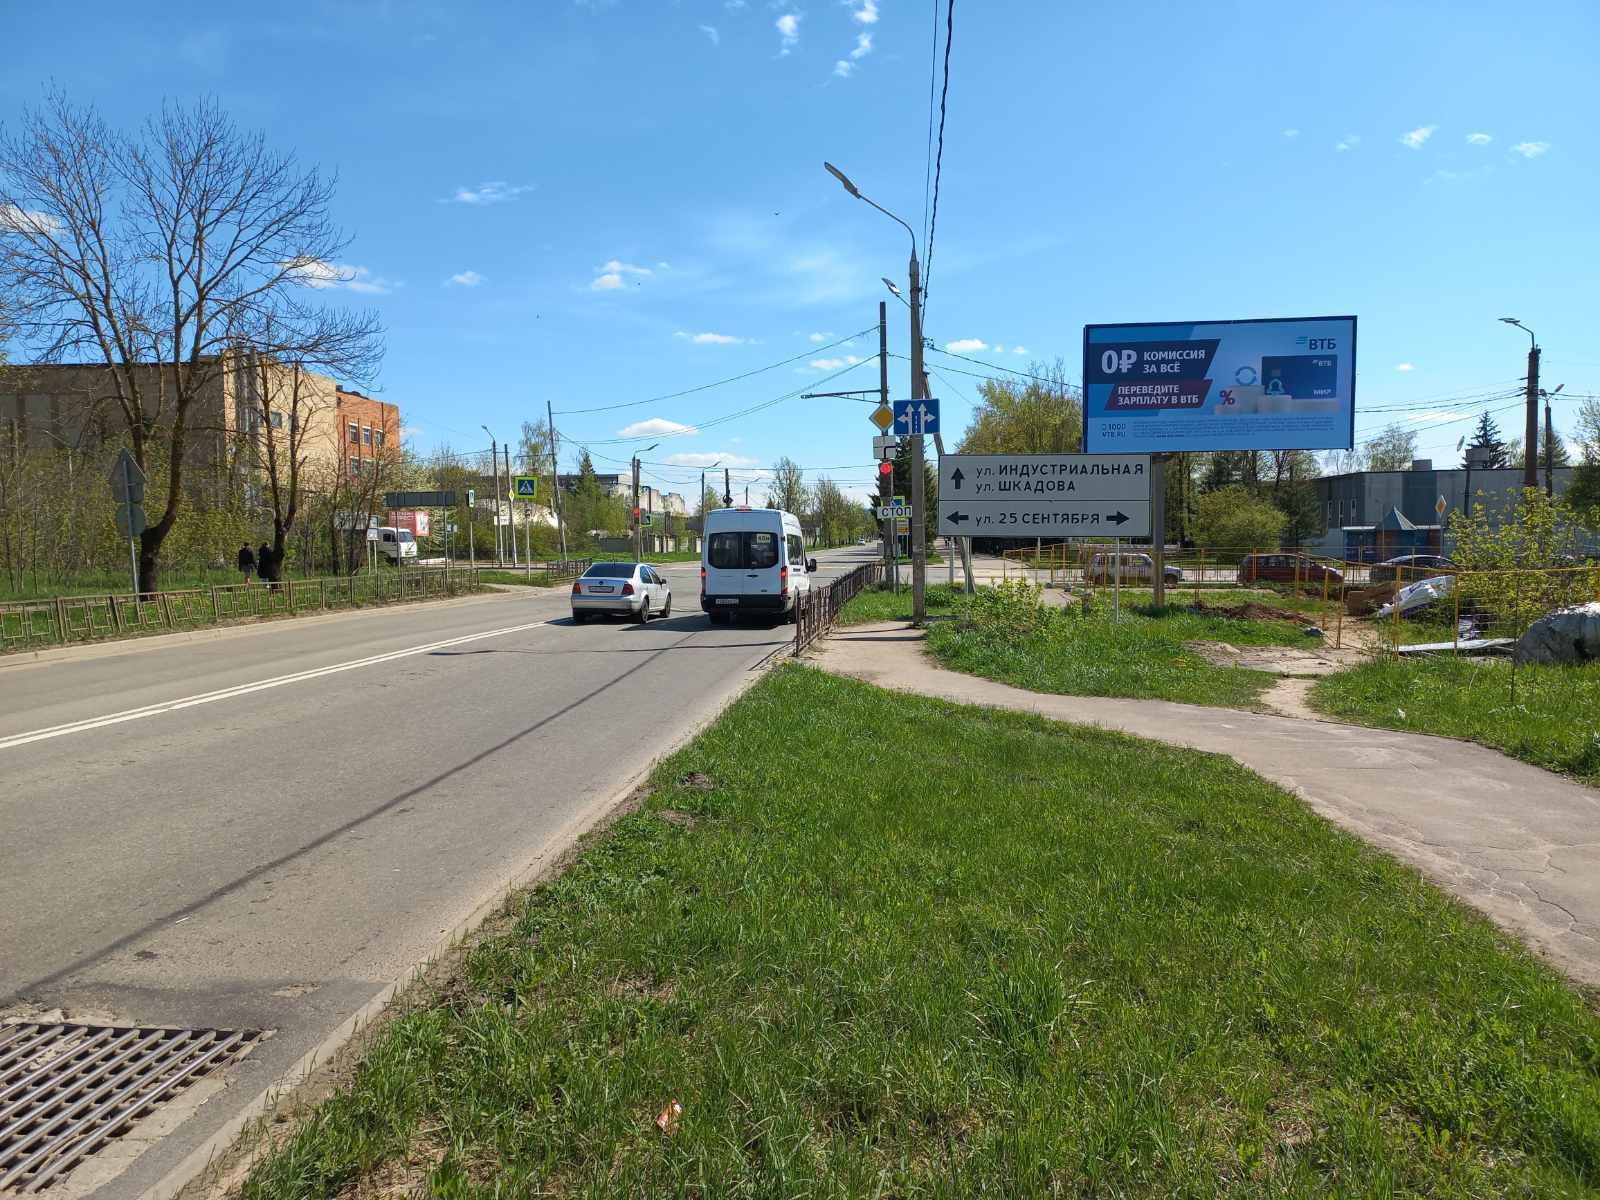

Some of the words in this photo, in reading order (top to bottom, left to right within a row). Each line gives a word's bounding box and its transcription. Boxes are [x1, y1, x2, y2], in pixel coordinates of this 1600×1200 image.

[1309, 338, 1337, 351] ВТБ
[1143, 349, 1206, 361] КОМИССИЯ
[1143, 364, 1158, 374] ЗА
[1160, 361, 1182, 373] ВСЁ
[1118, 384, 1180, 395] ПЕРЕВЕДИТЕ
[1118, 395, 1169, 406] ЗАРПЛАТУ
[1171, 395, 1178, 404] В
[1181, 394, 1200, 404] ВТБ
[976, 466, 995, 478] ул.
[999, 463, 1144, 478] ИНДУСТРИАЛЬНАЯ
[976, 482, 995, 494] ул.
[998, 480, 1076, 494] ШКАДОВА
[881, 507, 912, 517] СТОП
[976, 514, 995, 527] ул.
[999, 513, 1018, 524] 25
[1022, 513, 1100, 525] СЕНТЯБРЯ
